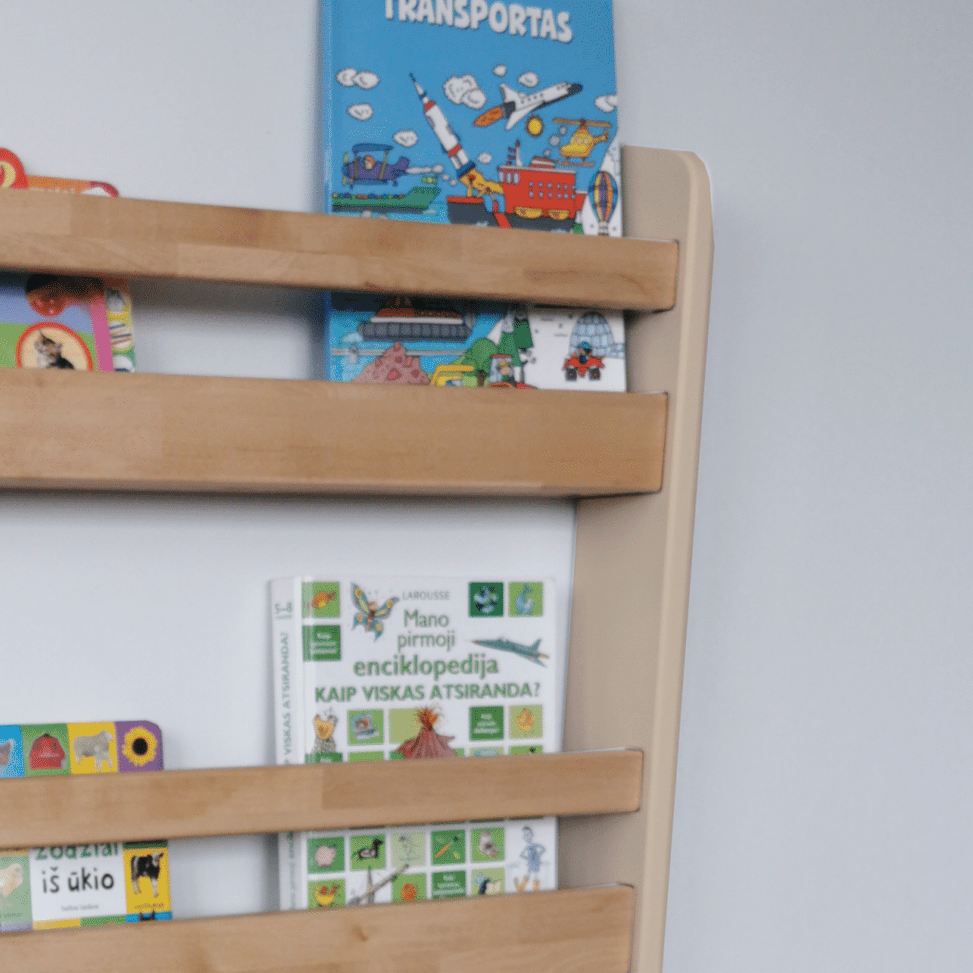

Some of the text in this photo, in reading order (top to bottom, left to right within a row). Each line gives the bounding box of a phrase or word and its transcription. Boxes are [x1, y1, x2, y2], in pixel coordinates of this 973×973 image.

[385, 0, 573, 43] TRANSPORTAS
[402, 590, 450, 602] LAROUSSE
[404, 609, 449, 628] Mano
[397, 631, 456, 652] pirmoji
[353, 654, 500, 680] enciklopedija
[314, 682, 541, 703] KAIP VISKAS ATSIRANDA?
[42, 866, 115, 894] iš ūkio
